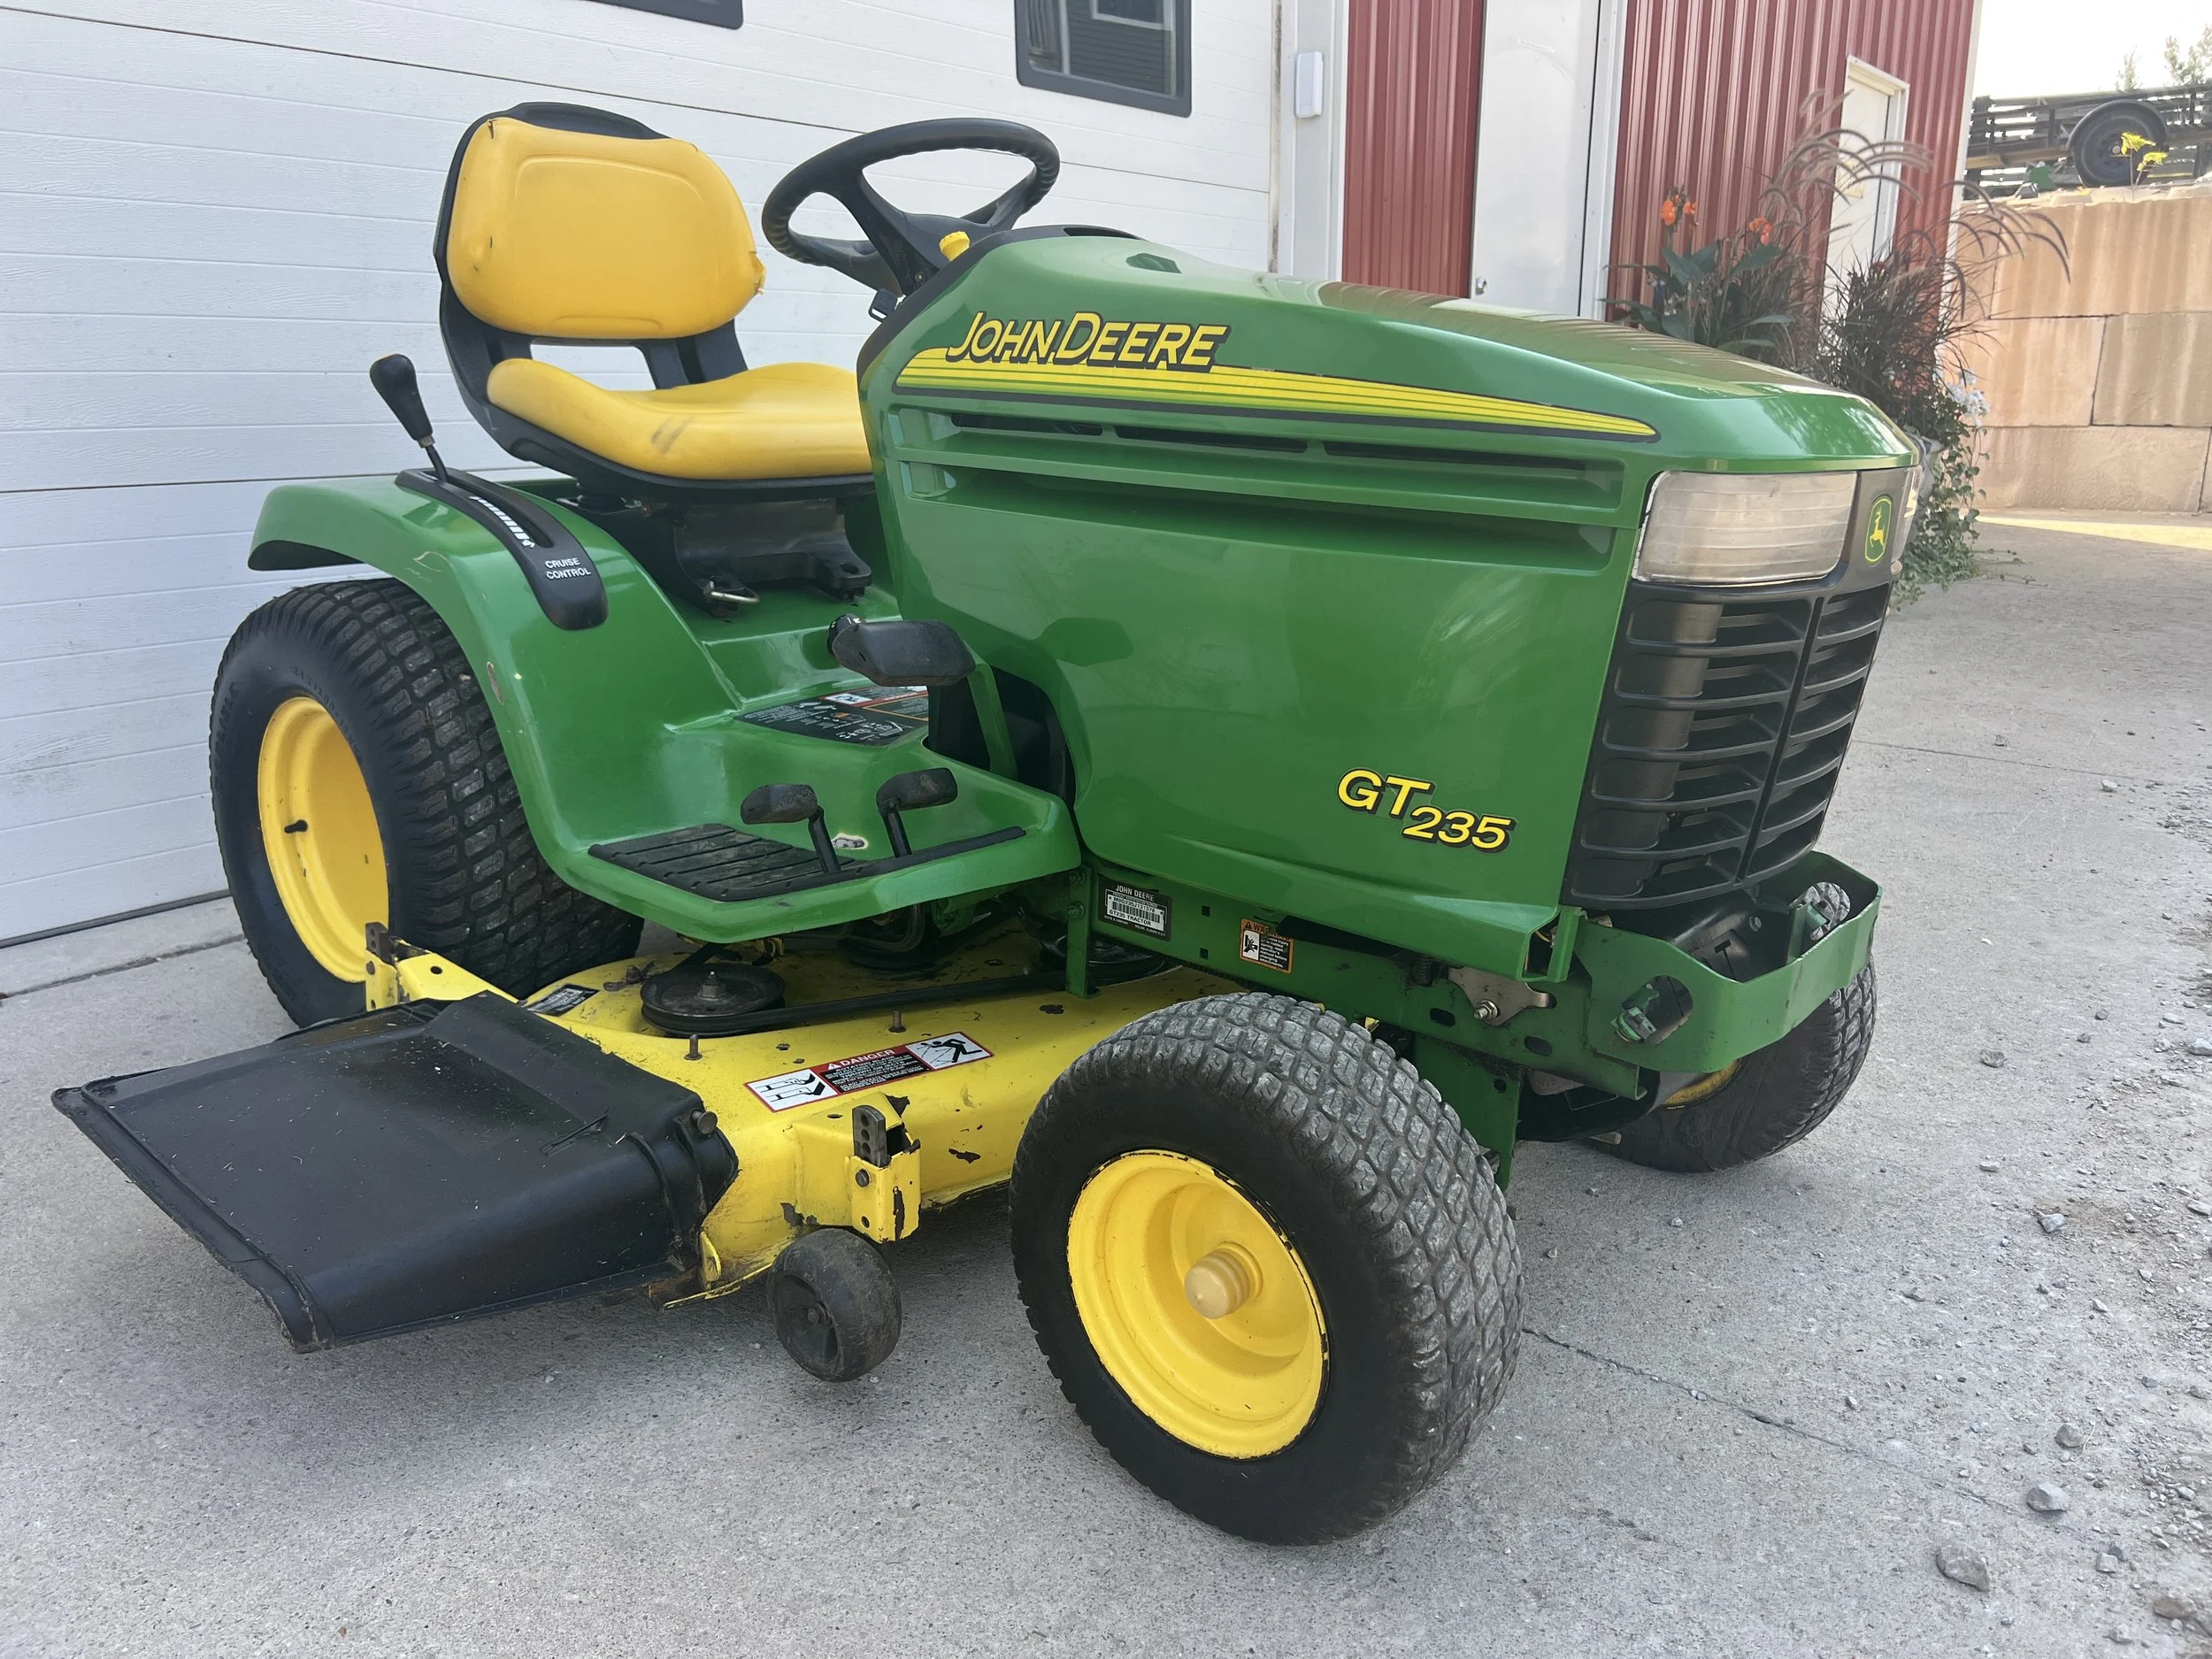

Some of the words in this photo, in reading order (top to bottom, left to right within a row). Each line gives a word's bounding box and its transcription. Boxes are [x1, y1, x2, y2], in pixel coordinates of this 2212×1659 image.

[947, 311, 1064, 364] JOHN
[1053, 311, 1231, 373] DEERE
[545, 557, 580, 569] CRUISE
[545, 567, 592, 580] CONTROL
[1116, 885, 1133, 895] JOHN
[1134, 889, 1154, 902] DEERE
[1127, 914, 1151, 926] TRACTOR
[840, 1049, 895, 1066] DANGER
